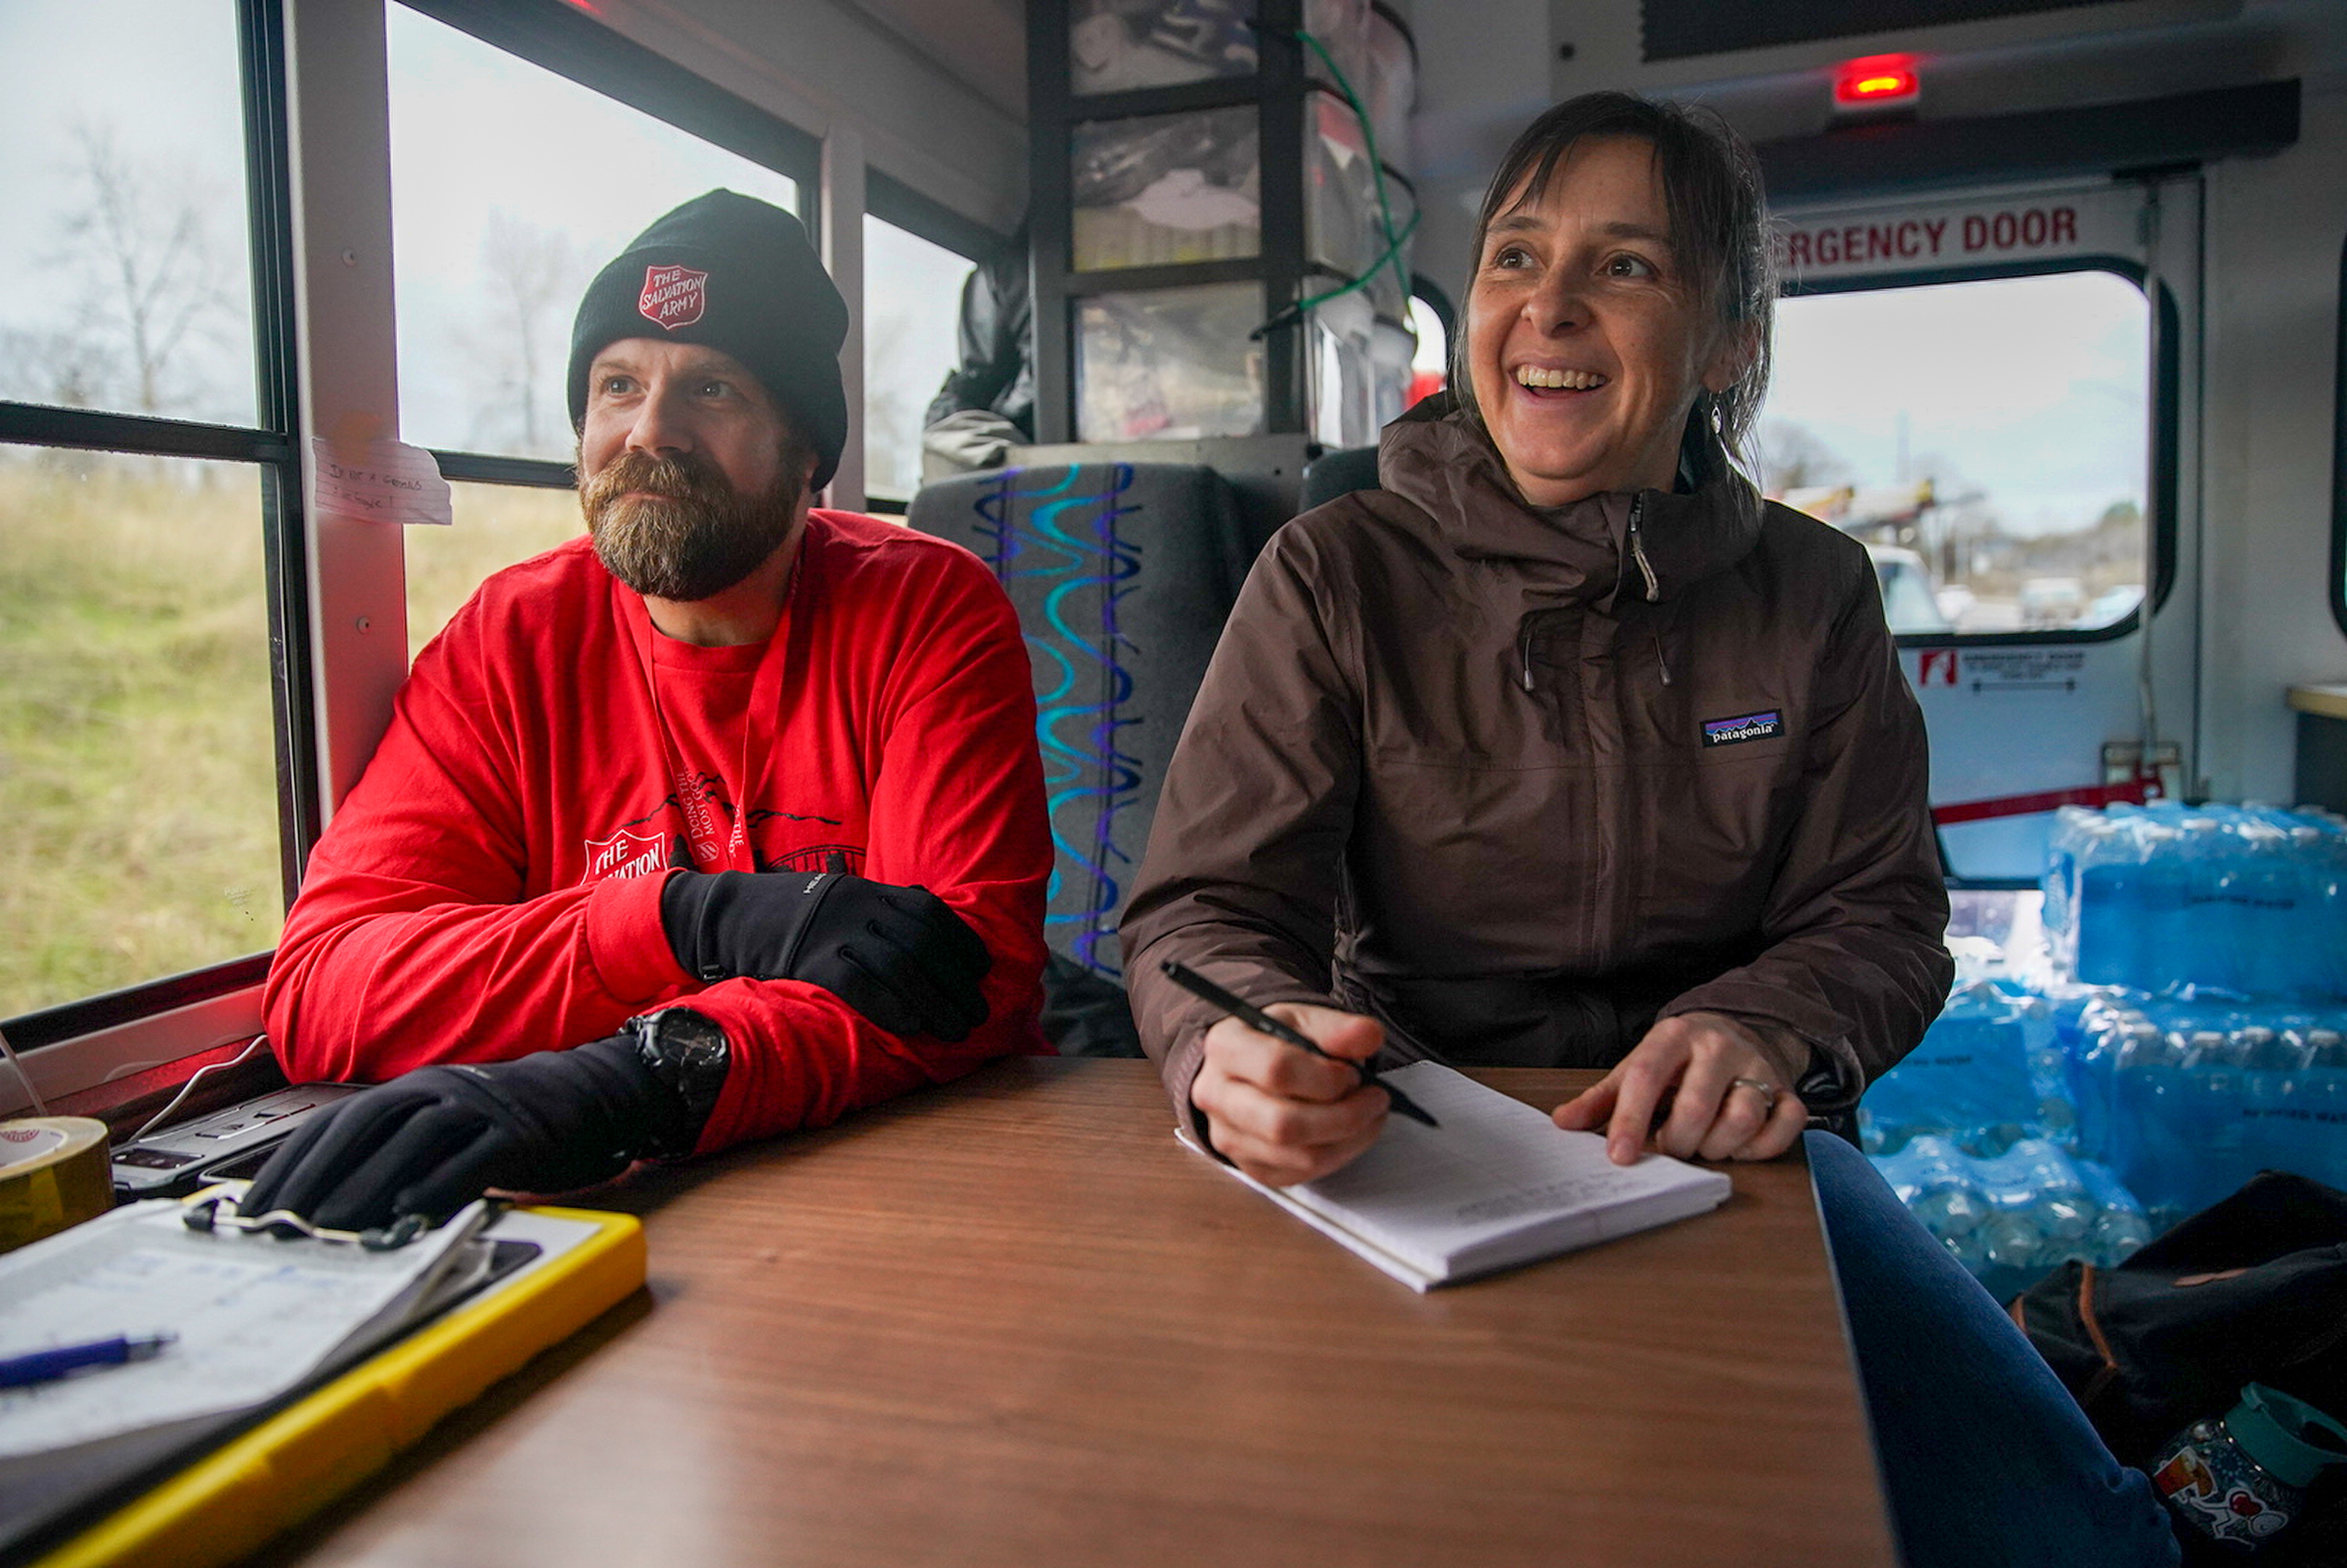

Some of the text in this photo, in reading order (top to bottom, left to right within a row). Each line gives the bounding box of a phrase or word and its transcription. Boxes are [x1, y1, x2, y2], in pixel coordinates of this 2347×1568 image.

[1787, 207, 2078, 268] RGENCY DOOR
[641, 276, 702, 310] SALVATION
[653, 269, 681, 287] THE
[658, 291, 698, 319] ARMY
[1713, 724, 1774, 744] patagonia
[683, 797, 703, 839] DOING
[696, 803, 715, 835] MOST
[595, 839, 629, 875] THE
